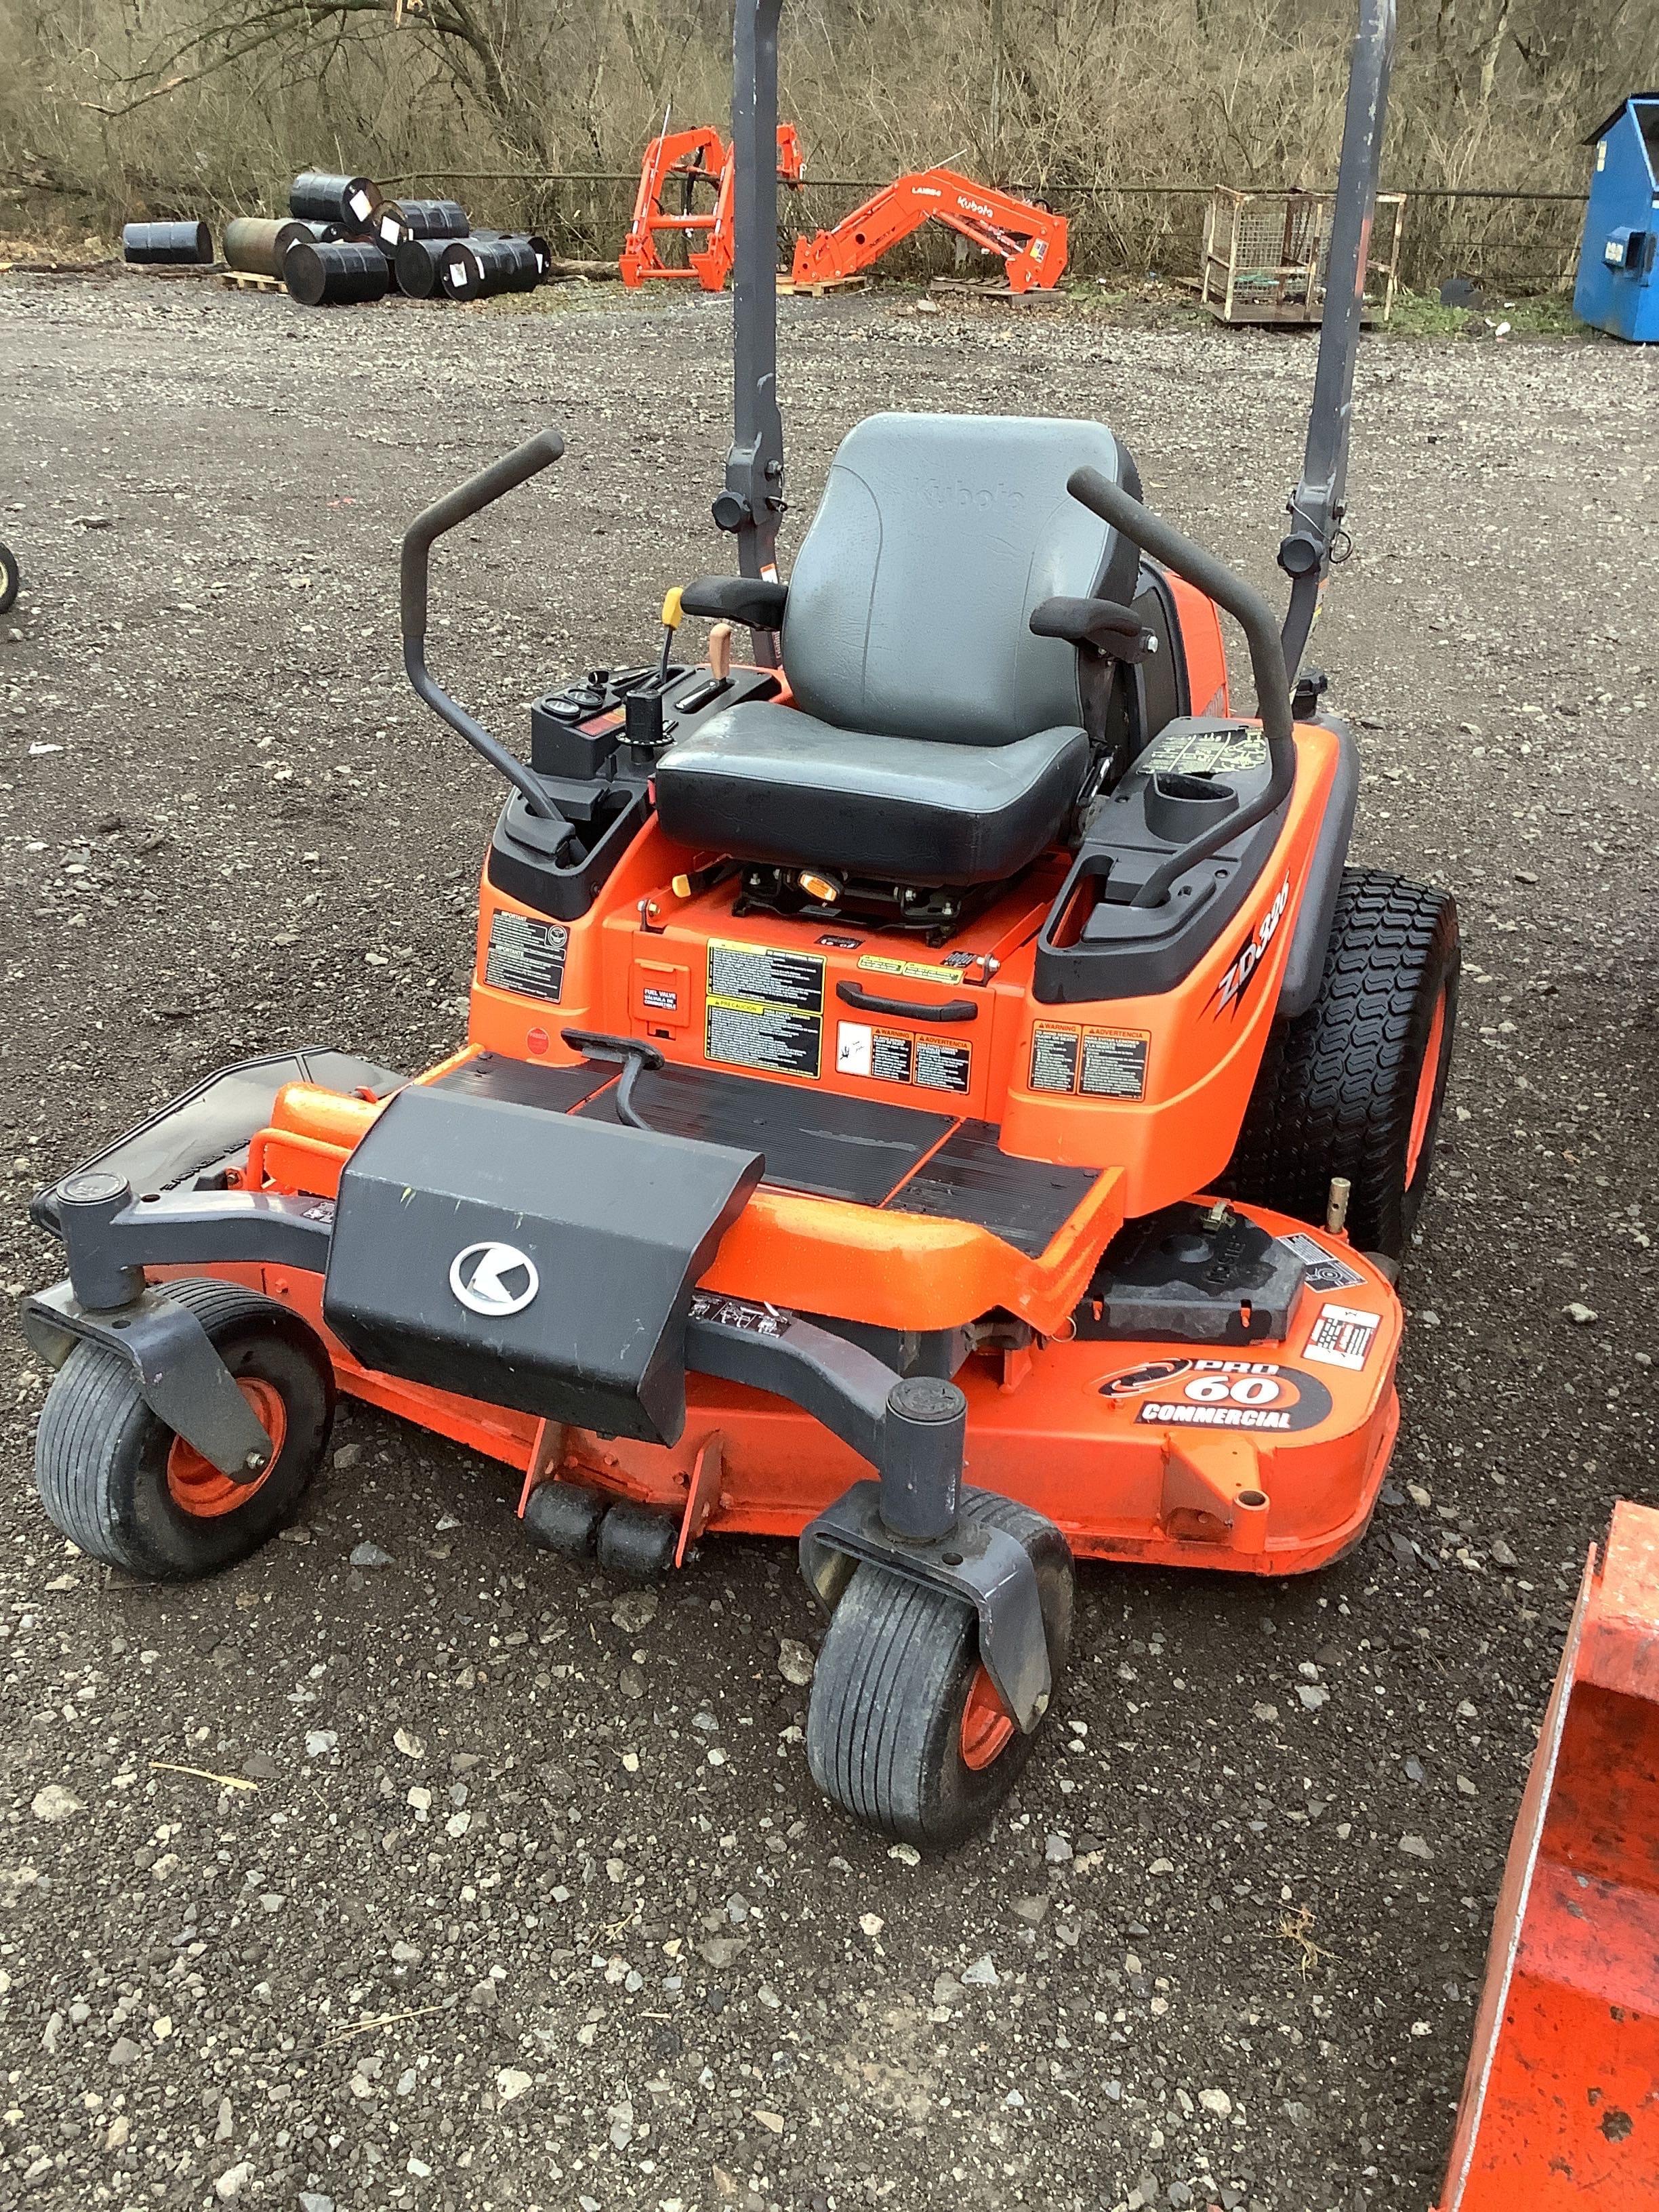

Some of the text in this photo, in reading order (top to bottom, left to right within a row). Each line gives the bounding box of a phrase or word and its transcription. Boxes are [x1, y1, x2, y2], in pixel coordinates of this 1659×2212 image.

[957, 196, 994, 218] Kubota
[644, 988, 676, 999] FUEL VALVE
[1044, 1023, 1076, 1032] WARNING
[881, 1029, 909, 1038] WARNING
[1095, 1029, 1143, 1038] ADVERTENCIA
[925, 1037, 968, 1048] ADVERTENCIA
[1195, 1359, 1279, 1375] PRO
[1185, 1376, 1279, 1404] 60
[1141, 1404, 1291, 1429] COMMERCIAL
